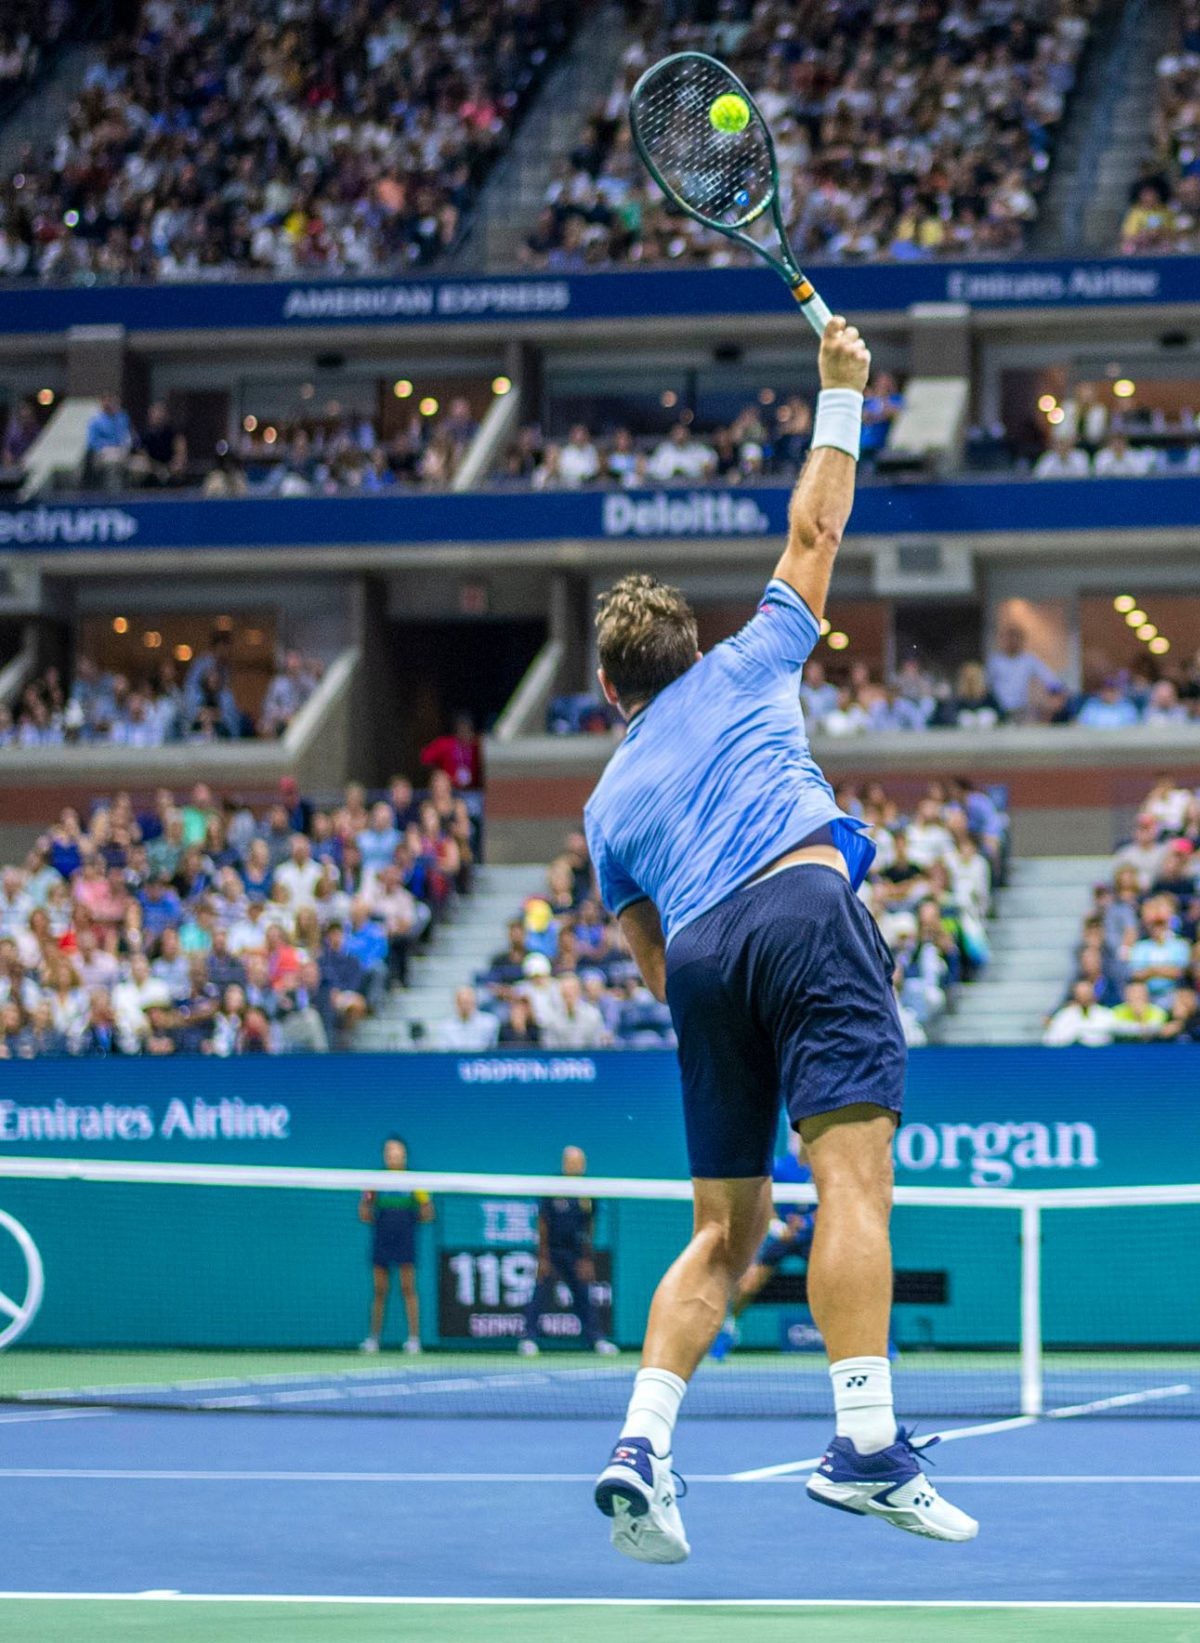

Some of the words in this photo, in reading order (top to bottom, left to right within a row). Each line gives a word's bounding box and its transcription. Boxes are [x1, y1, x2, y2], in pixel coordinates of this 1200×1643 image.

[284, 288, 431, 318] AMERICAN
[436, 282, 570, 314] EXPRESS
[1069, 267, 1160, 297] Airline
[0, 1098, 154, 1140] Emirates
[160, 1096, 290, 1139] Airline
[893, 1121, 1098, 1187] organ
[482, 1202, 539, 1243] IB
[449, 1251, 539, 1307] 119
